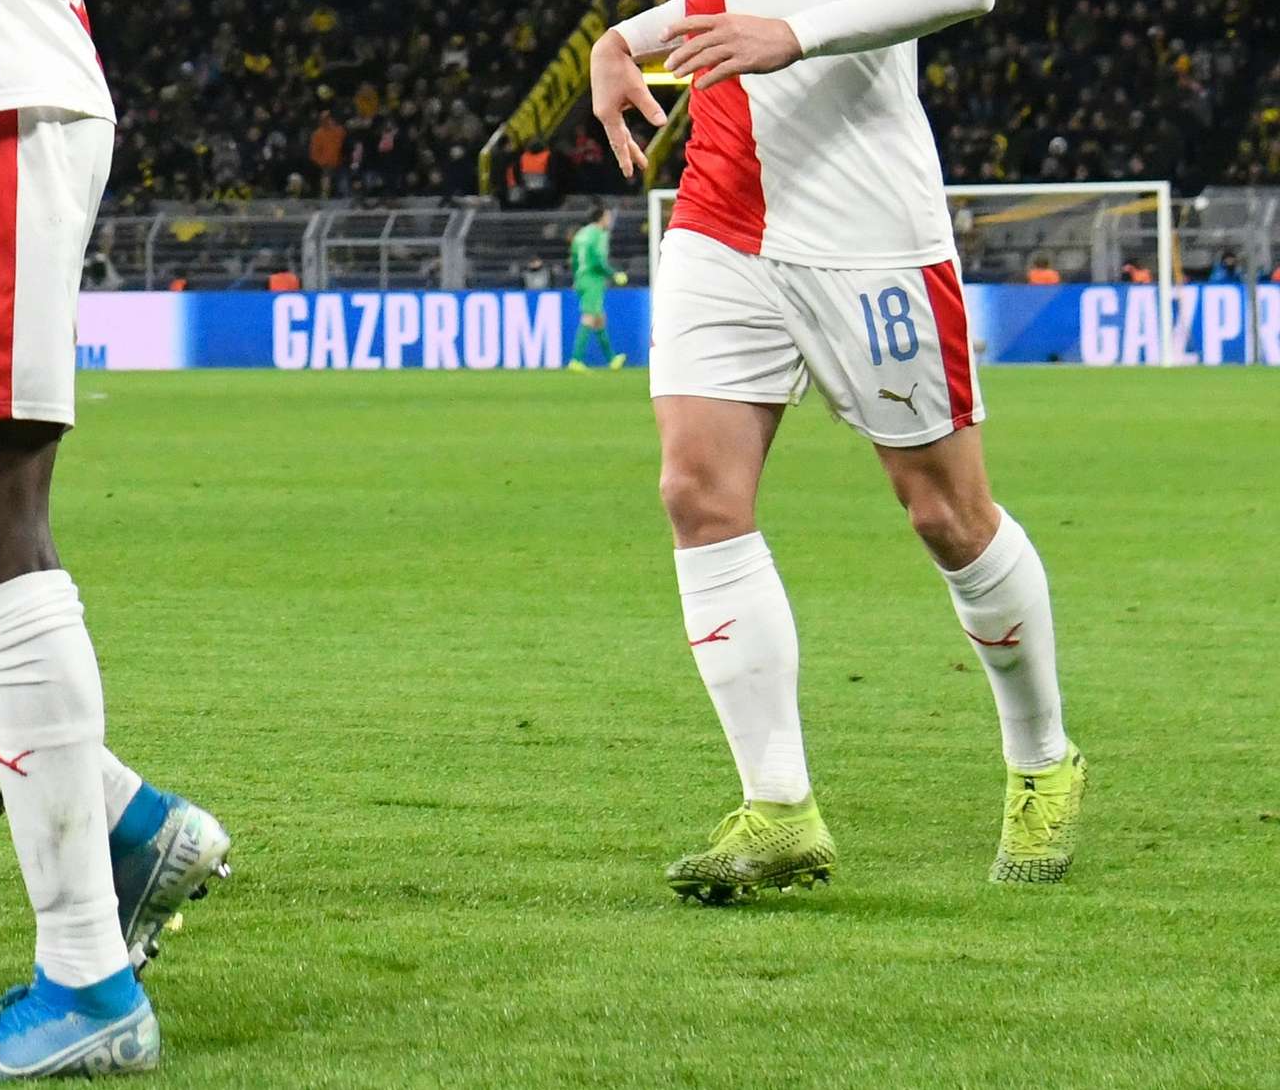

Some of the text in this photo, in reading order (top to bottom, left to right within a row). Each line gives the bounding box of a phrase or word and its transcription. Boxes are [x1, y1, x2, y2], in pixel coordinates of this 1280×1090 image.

[272, 291, 563, 370] GAZPROM
[859, 286, 920, 367] 18
[1079, 285, 1280, 367] GAZPR
